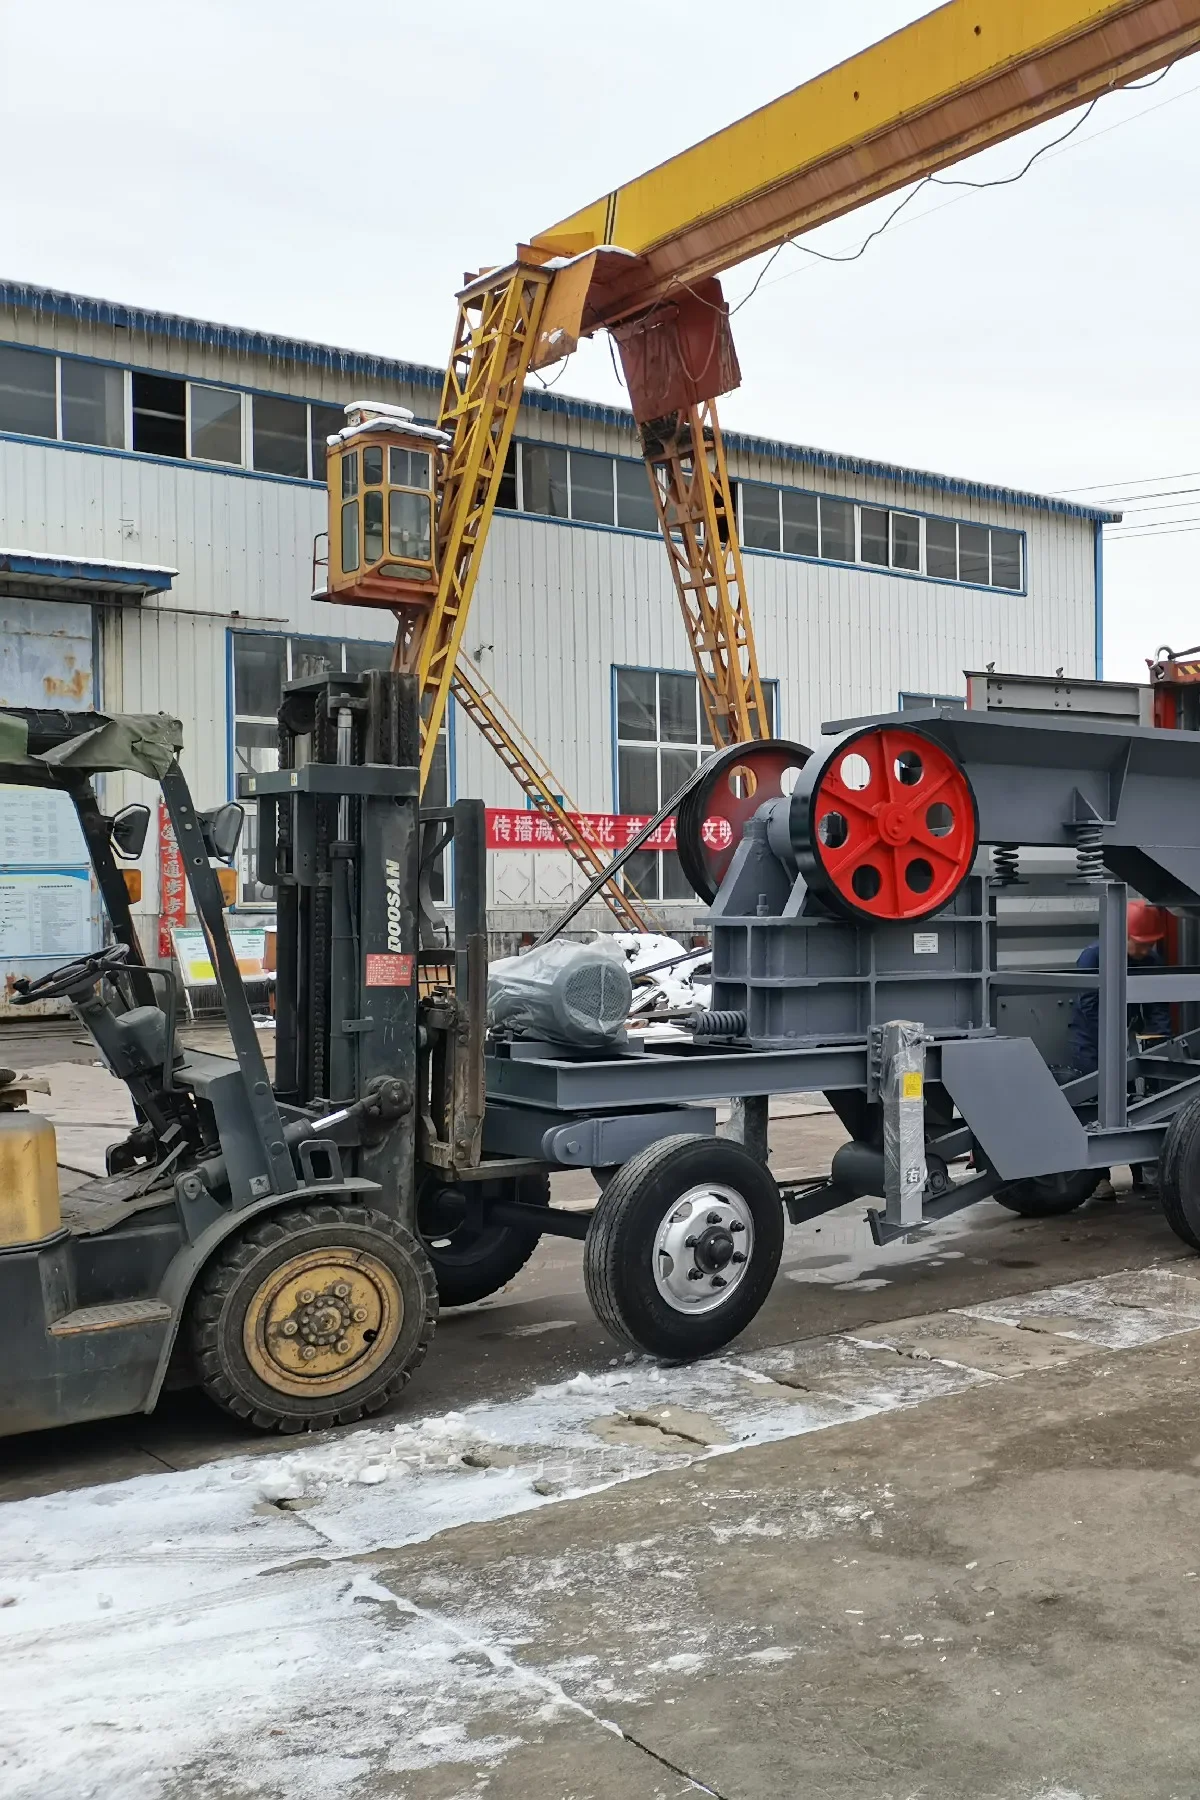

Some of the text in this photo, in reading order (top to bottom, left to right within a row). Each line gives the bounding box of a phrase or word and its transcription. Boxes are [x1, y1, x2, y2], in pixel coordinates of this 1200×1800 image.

[626, 817, 733, 844] 共创人文明
[385, 859, 401, 953] DOOSAN
